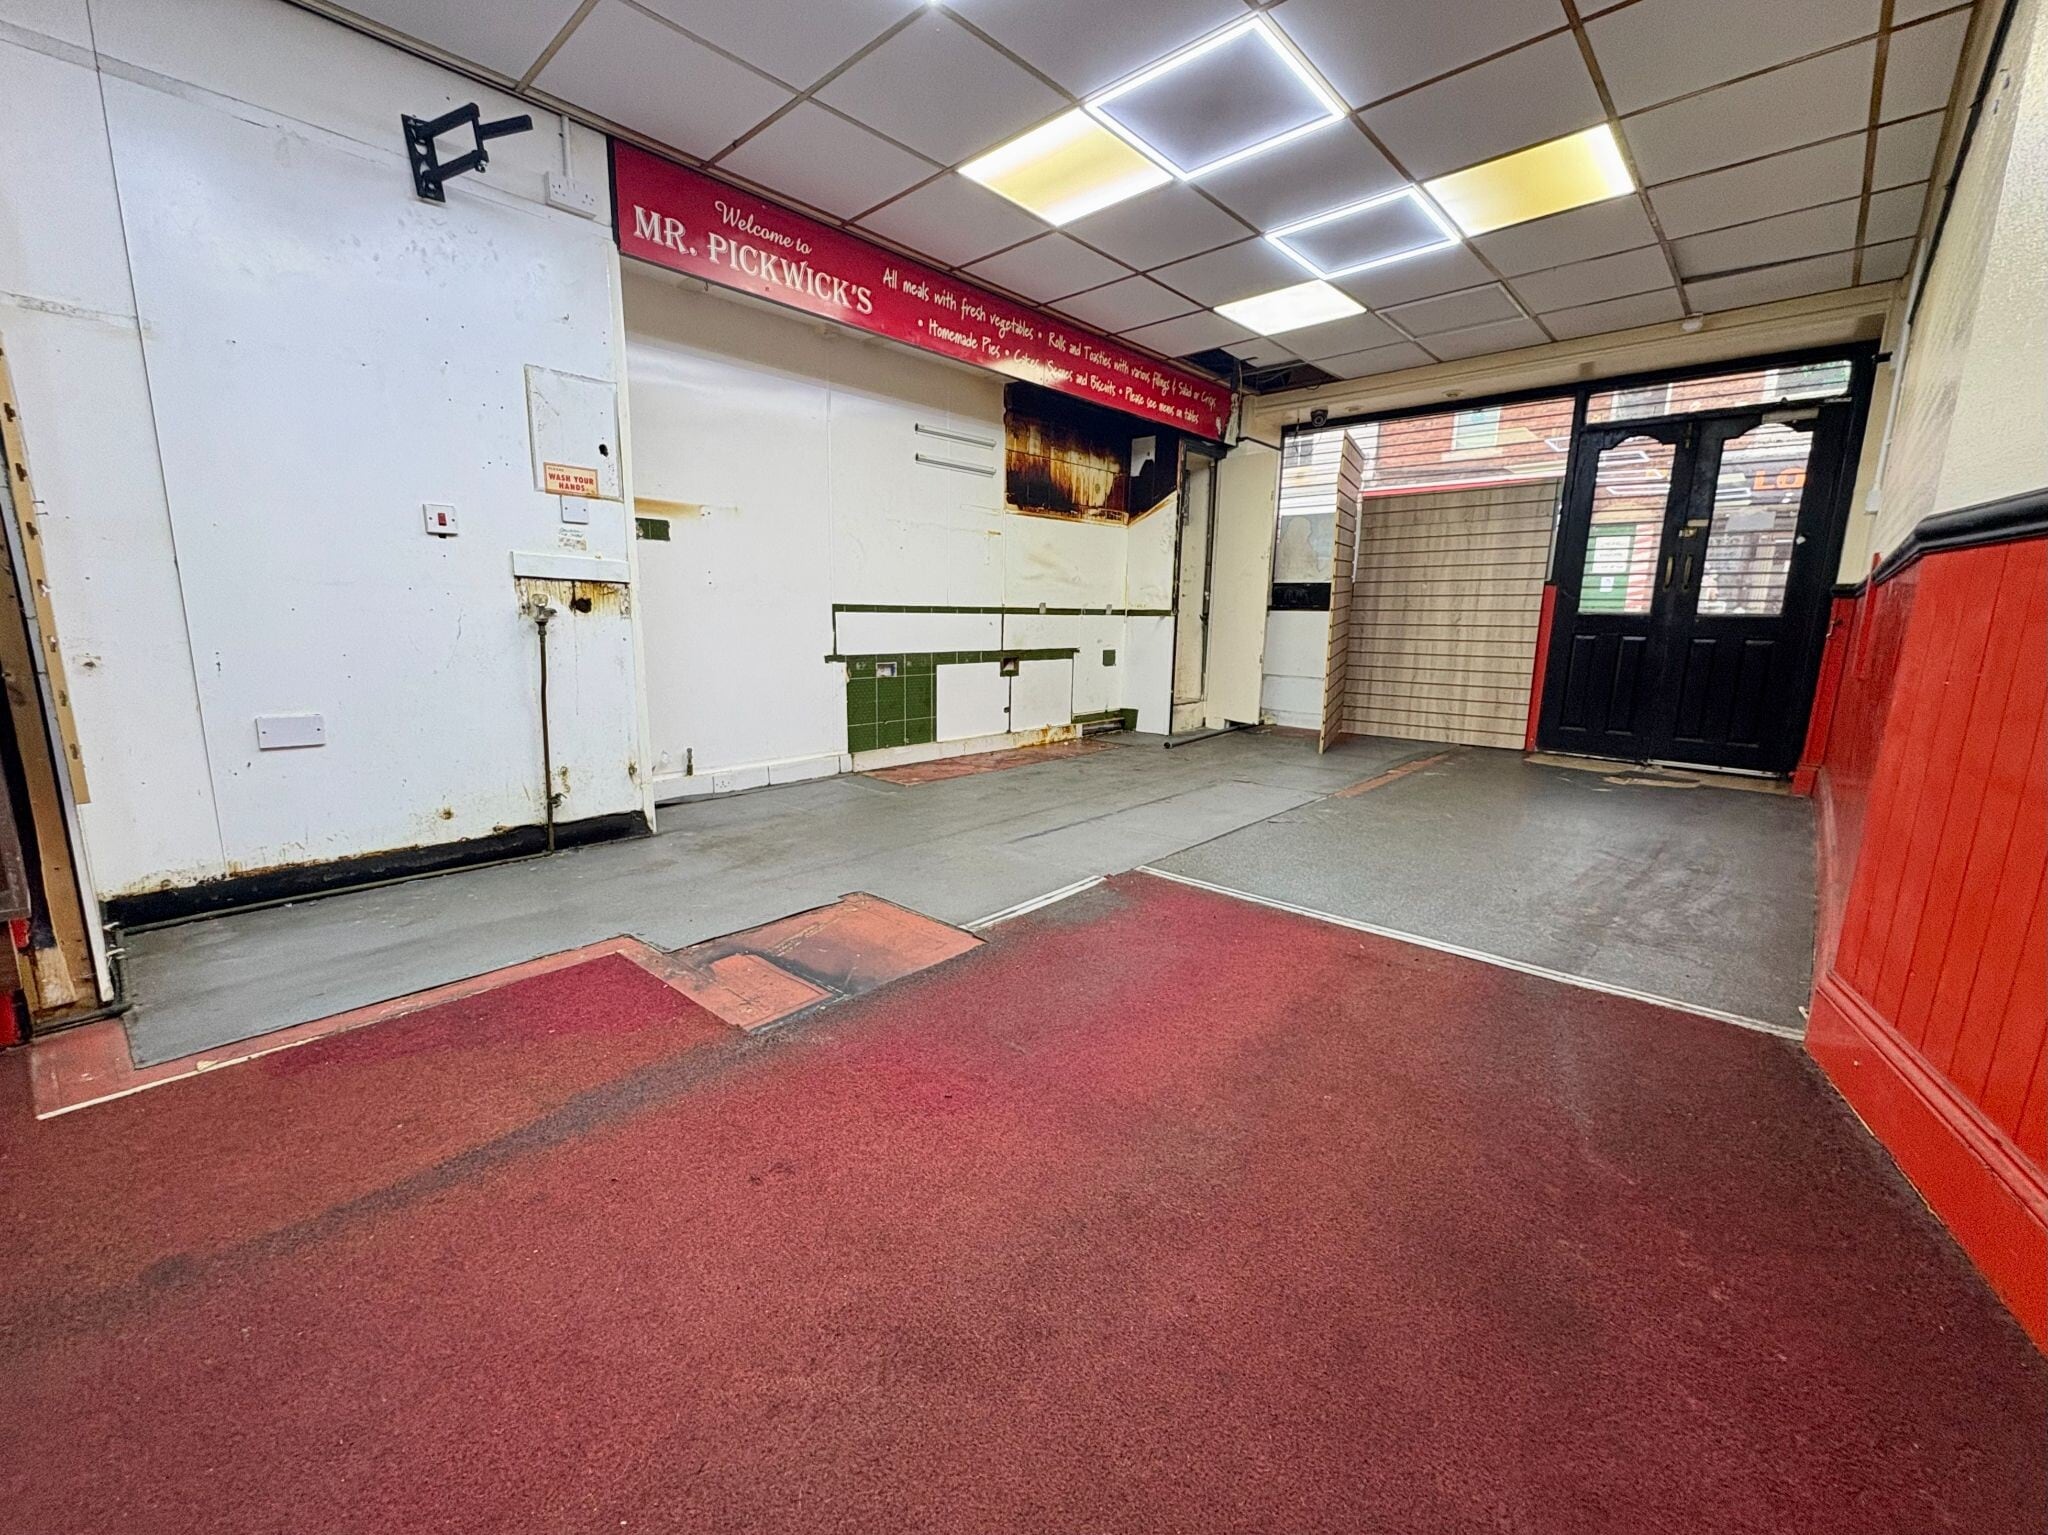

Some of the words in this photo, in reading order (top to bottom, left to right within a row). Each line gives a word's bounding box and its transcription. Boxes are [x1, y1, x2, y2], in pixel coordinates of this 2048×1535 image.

[633, 204, 698, 256] MR.
[706, 231, 874, 315] PICKWICK'S
[714, 200, 794, 249] Welcome
[796, 237, 813, 255] to
[883, 267, 898, 290] All
[903, 280, 929, 301] meals
[934, 289, 957, 311] with
[961, 298, 986, 321] fresh
[990, 312, 1034, 340] vegetables
[1048, 331, 1067, 353] Rolls
[1069, 342, 1081, 357] and
[1084, 346, 1112, 370] Toasties
[1114, 358, 1129, 377] with
[1131, 365, 1150, 383] various
[1178, 381, 1193, 398] Salad
[1193, 391, 1200, 401] or
[929, 318, 978, 349] Homemade
[981, 337, 1000, 359] Pies
[1046, 358, 1074, 383] Scones
[1076, 372, 1088, 387] and
[1090, 376, 1116, 397] Biscuits
[1125, 386, 1144, 405] Please
[1146, 398, 1157, 410] see
[1159, 403, 1175, 418] menus
[1176, 409, 1183, 419] on
[1184, 408, 1200, 425] tables
[548, 472, 571, 482] WASH
[574, 475, 594, 486] YOUR
[558, 482, 585, 492] HANDS
